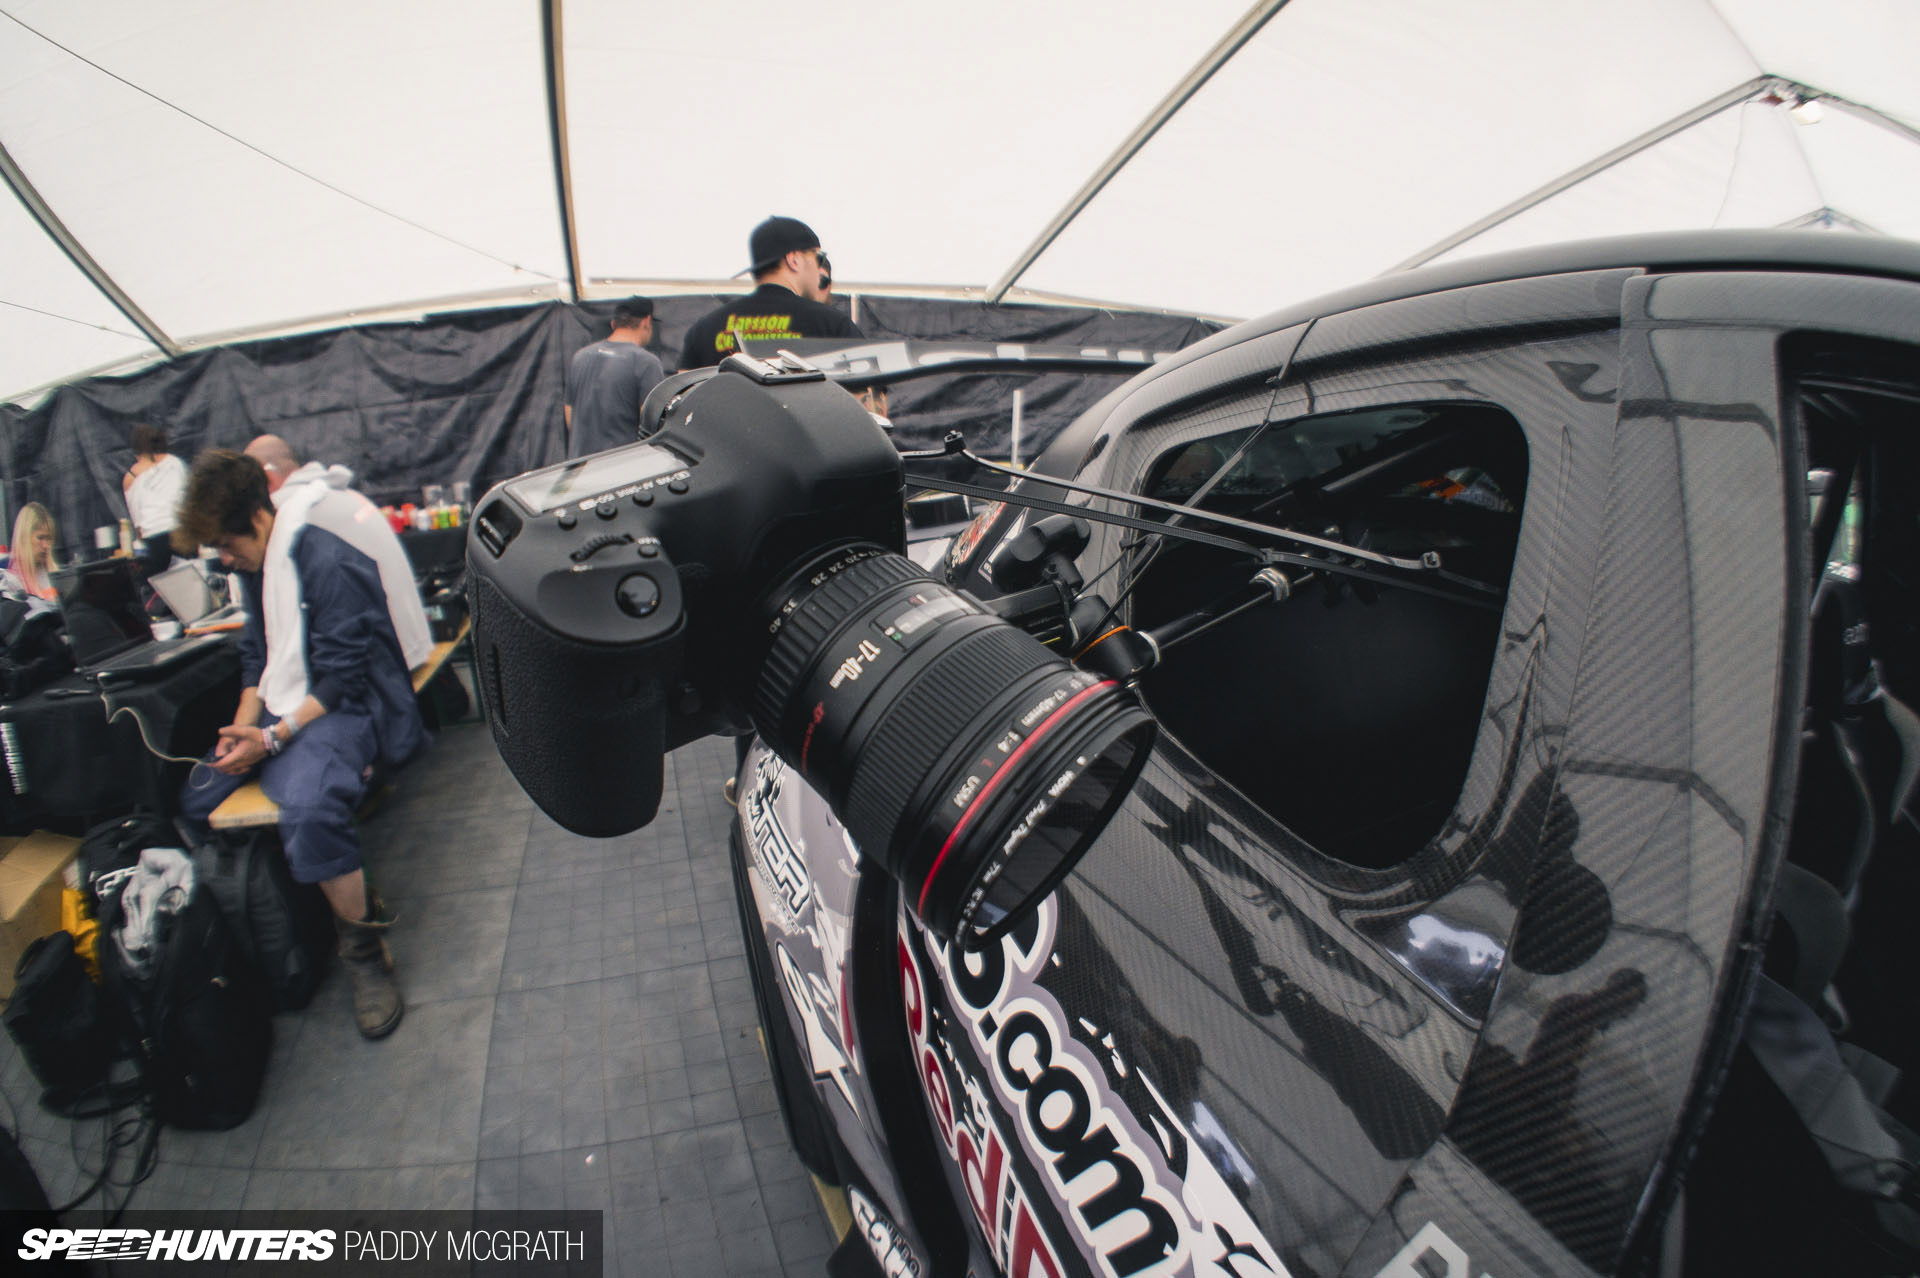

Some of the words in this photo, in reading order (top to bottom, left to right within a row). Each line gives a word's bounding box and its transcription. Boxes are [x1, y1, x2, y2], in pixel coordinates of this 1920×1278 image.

[726, 314, 791, 331] Larsson
[830, 640, 881, 688] 17-40mm
[954, 776, 981, 808] USM
